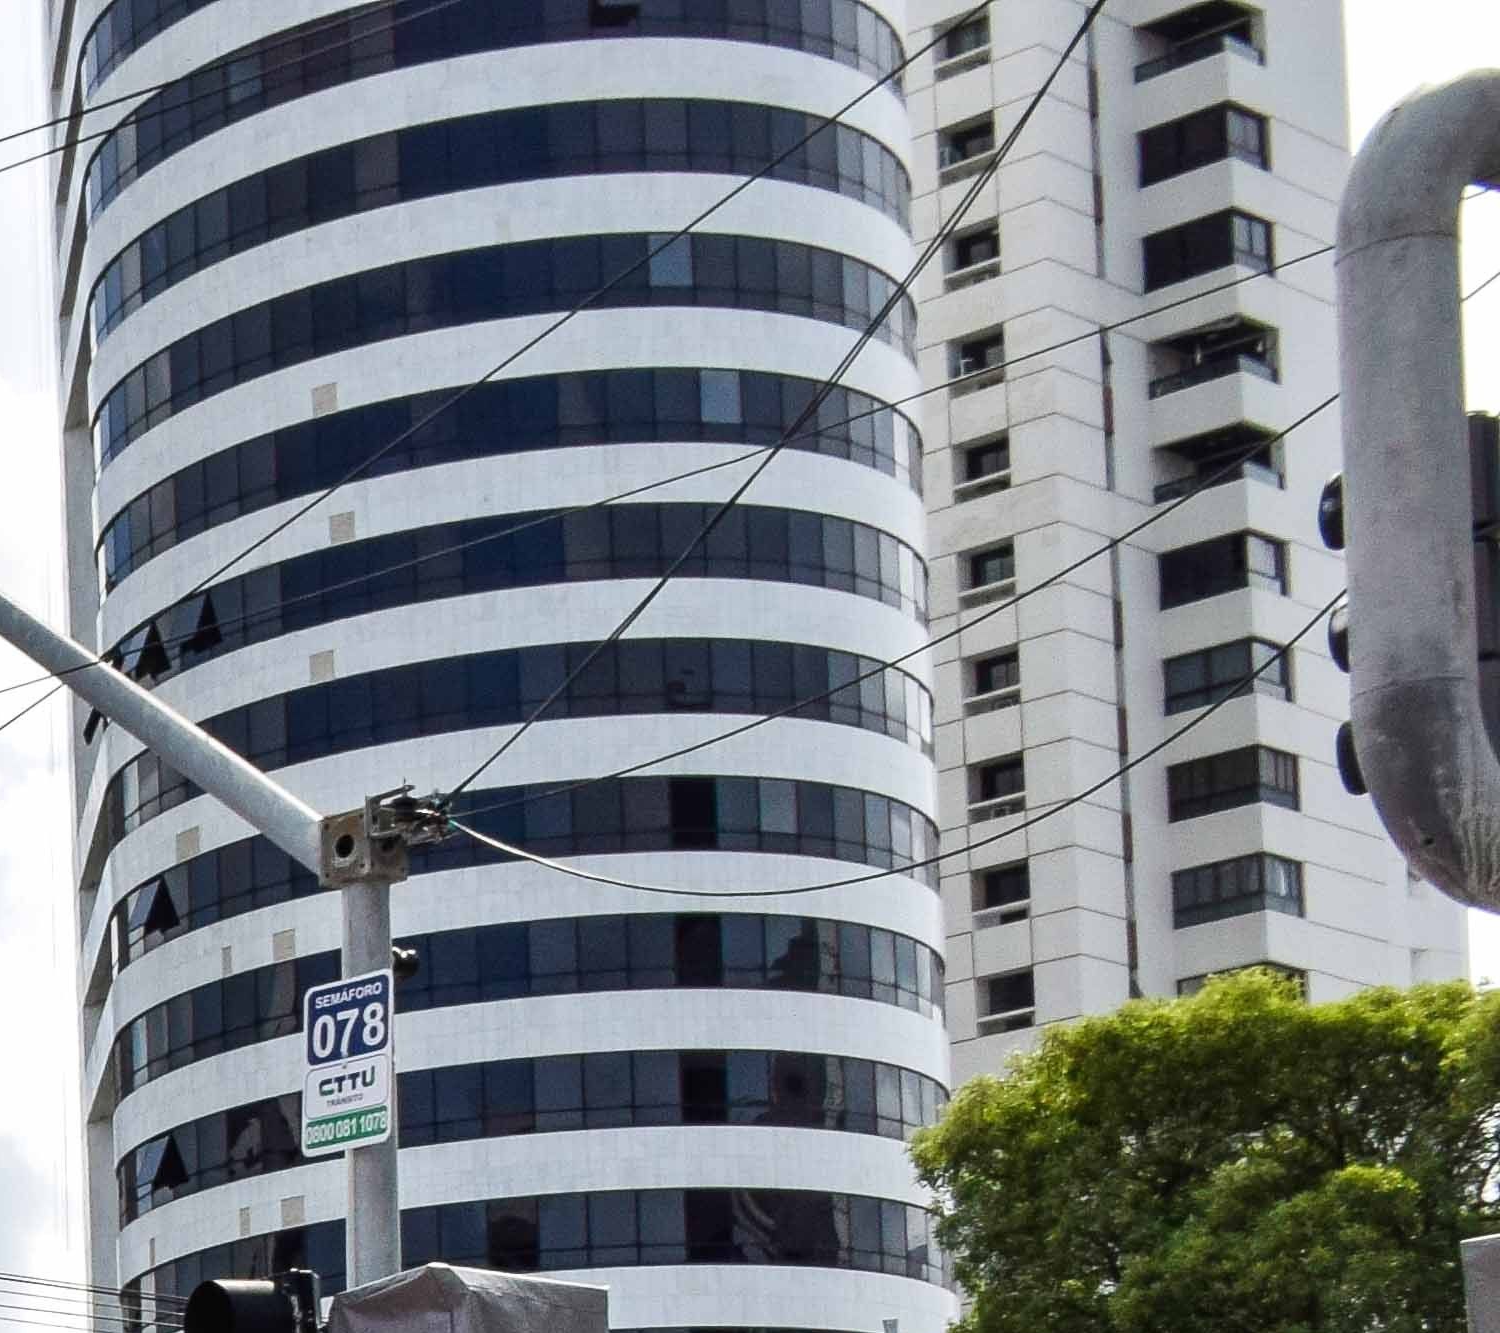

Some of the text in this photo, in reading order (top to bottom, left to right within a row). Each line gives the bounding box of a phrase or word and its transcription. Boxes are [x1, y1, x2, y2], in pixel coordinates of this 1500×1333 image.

[315, 981, 382, 1009] SEMÁFORO
[312, 1001, 385, 1059] 078
[319, 1065, 375, 1097] CTTU
[306, 1110, 387, 1145] 0800 081 1078
